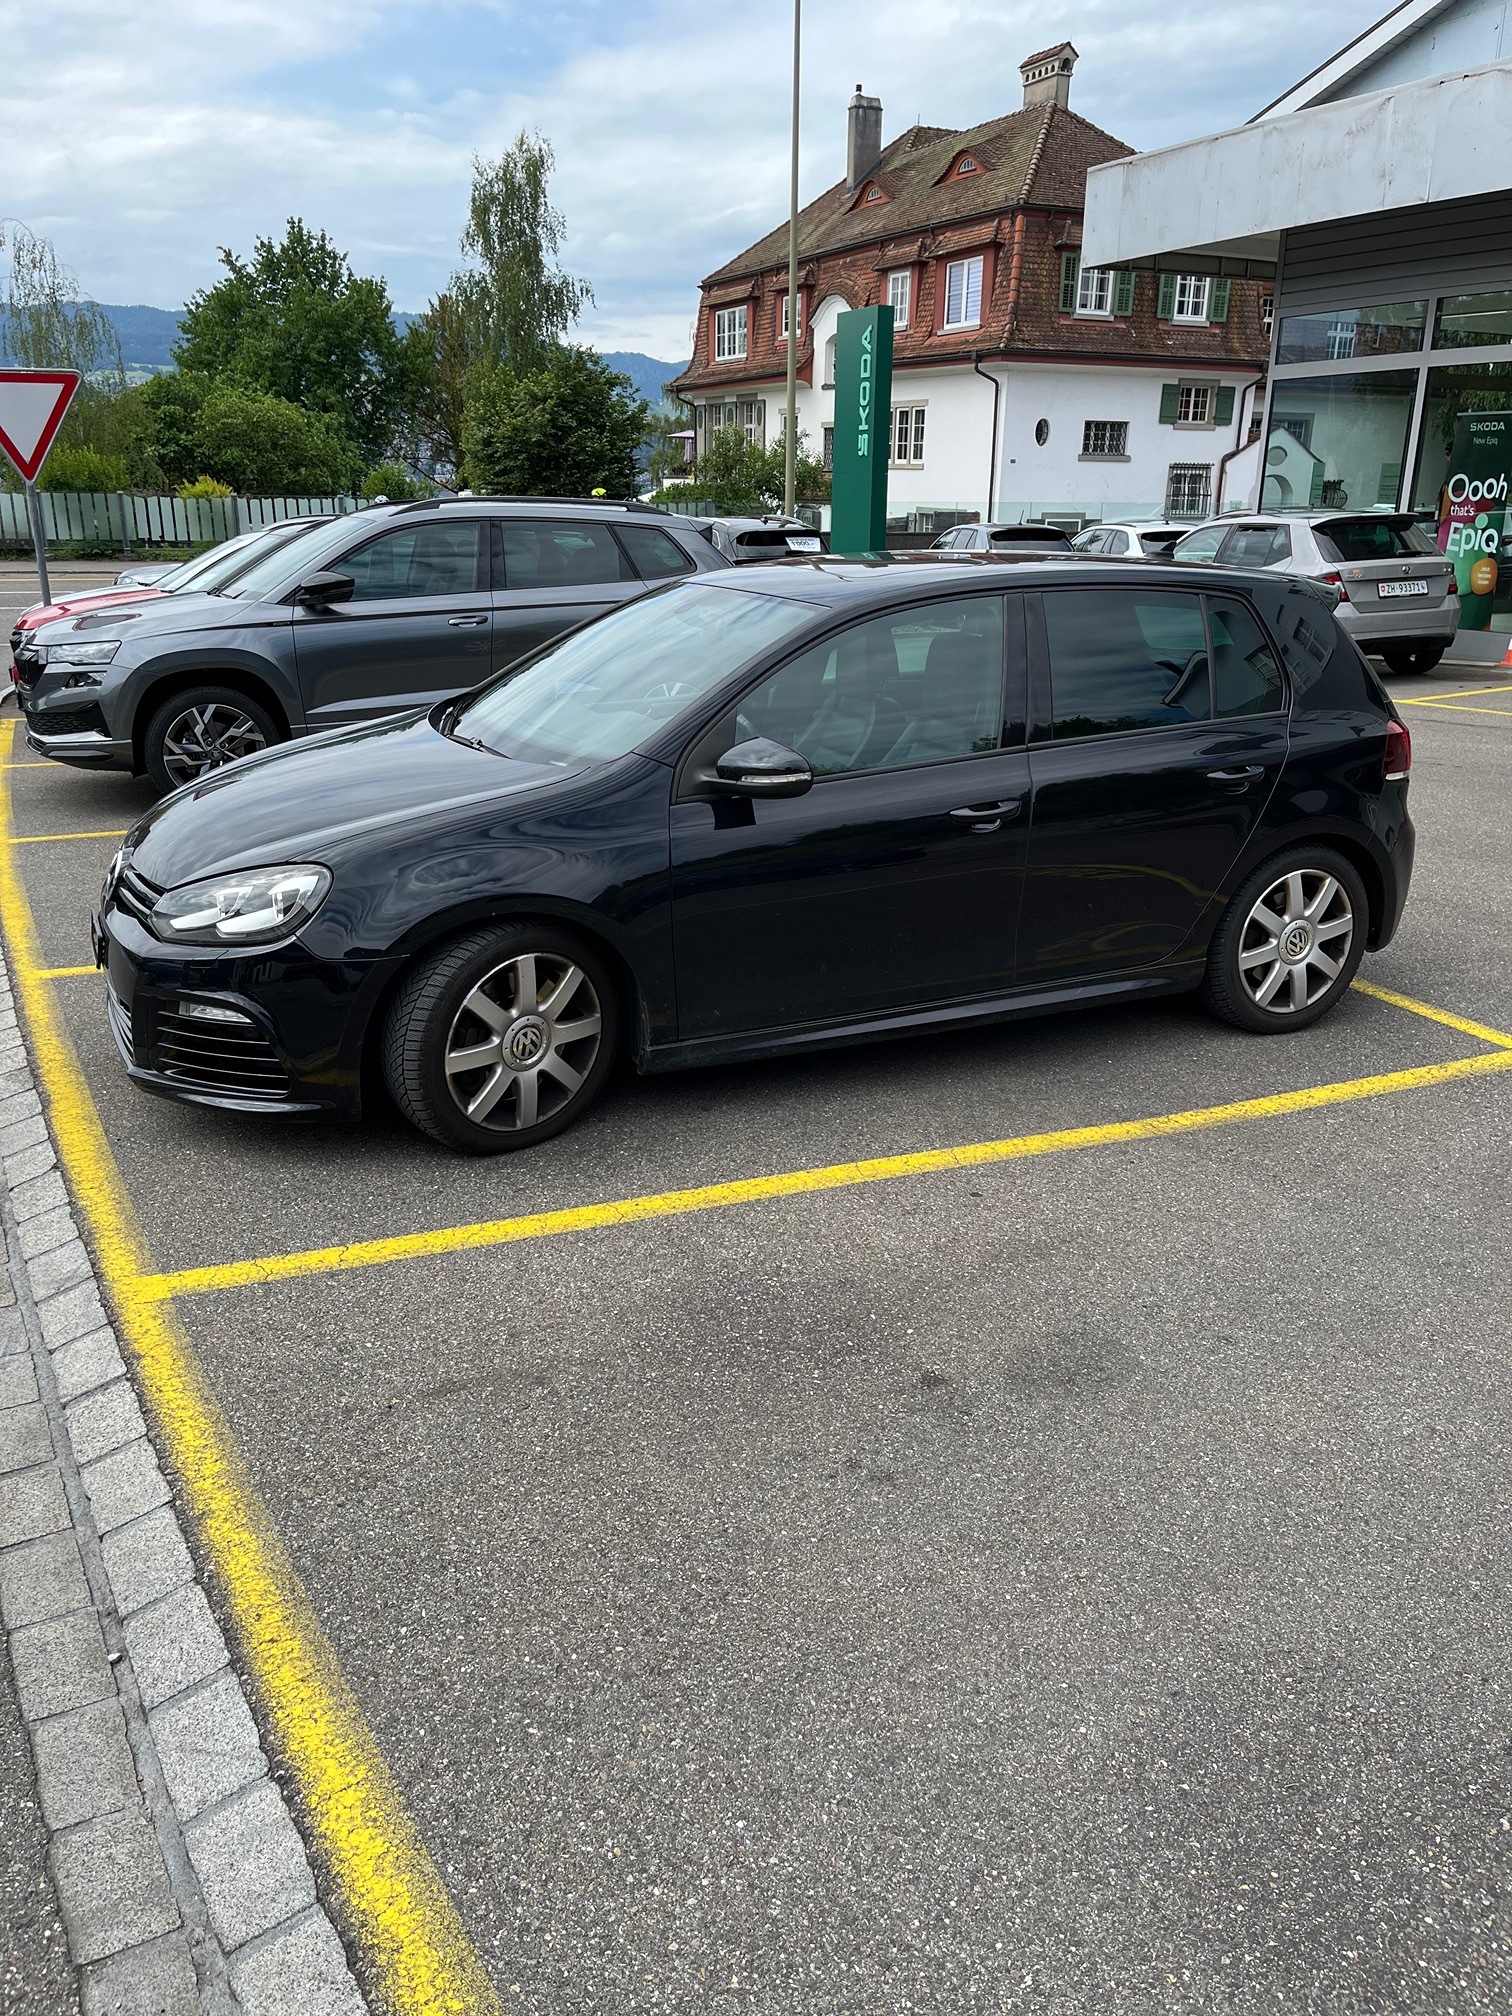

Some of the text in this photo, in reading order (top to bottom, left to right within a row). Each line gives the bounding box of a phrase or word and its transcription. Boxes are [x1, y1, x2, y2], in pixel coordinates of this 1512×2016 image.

[1470, 421, 1505, 431] SKODA
[1448, 473, 1508, 503] Oooh
[1450, 505, 1475, 516] that's
